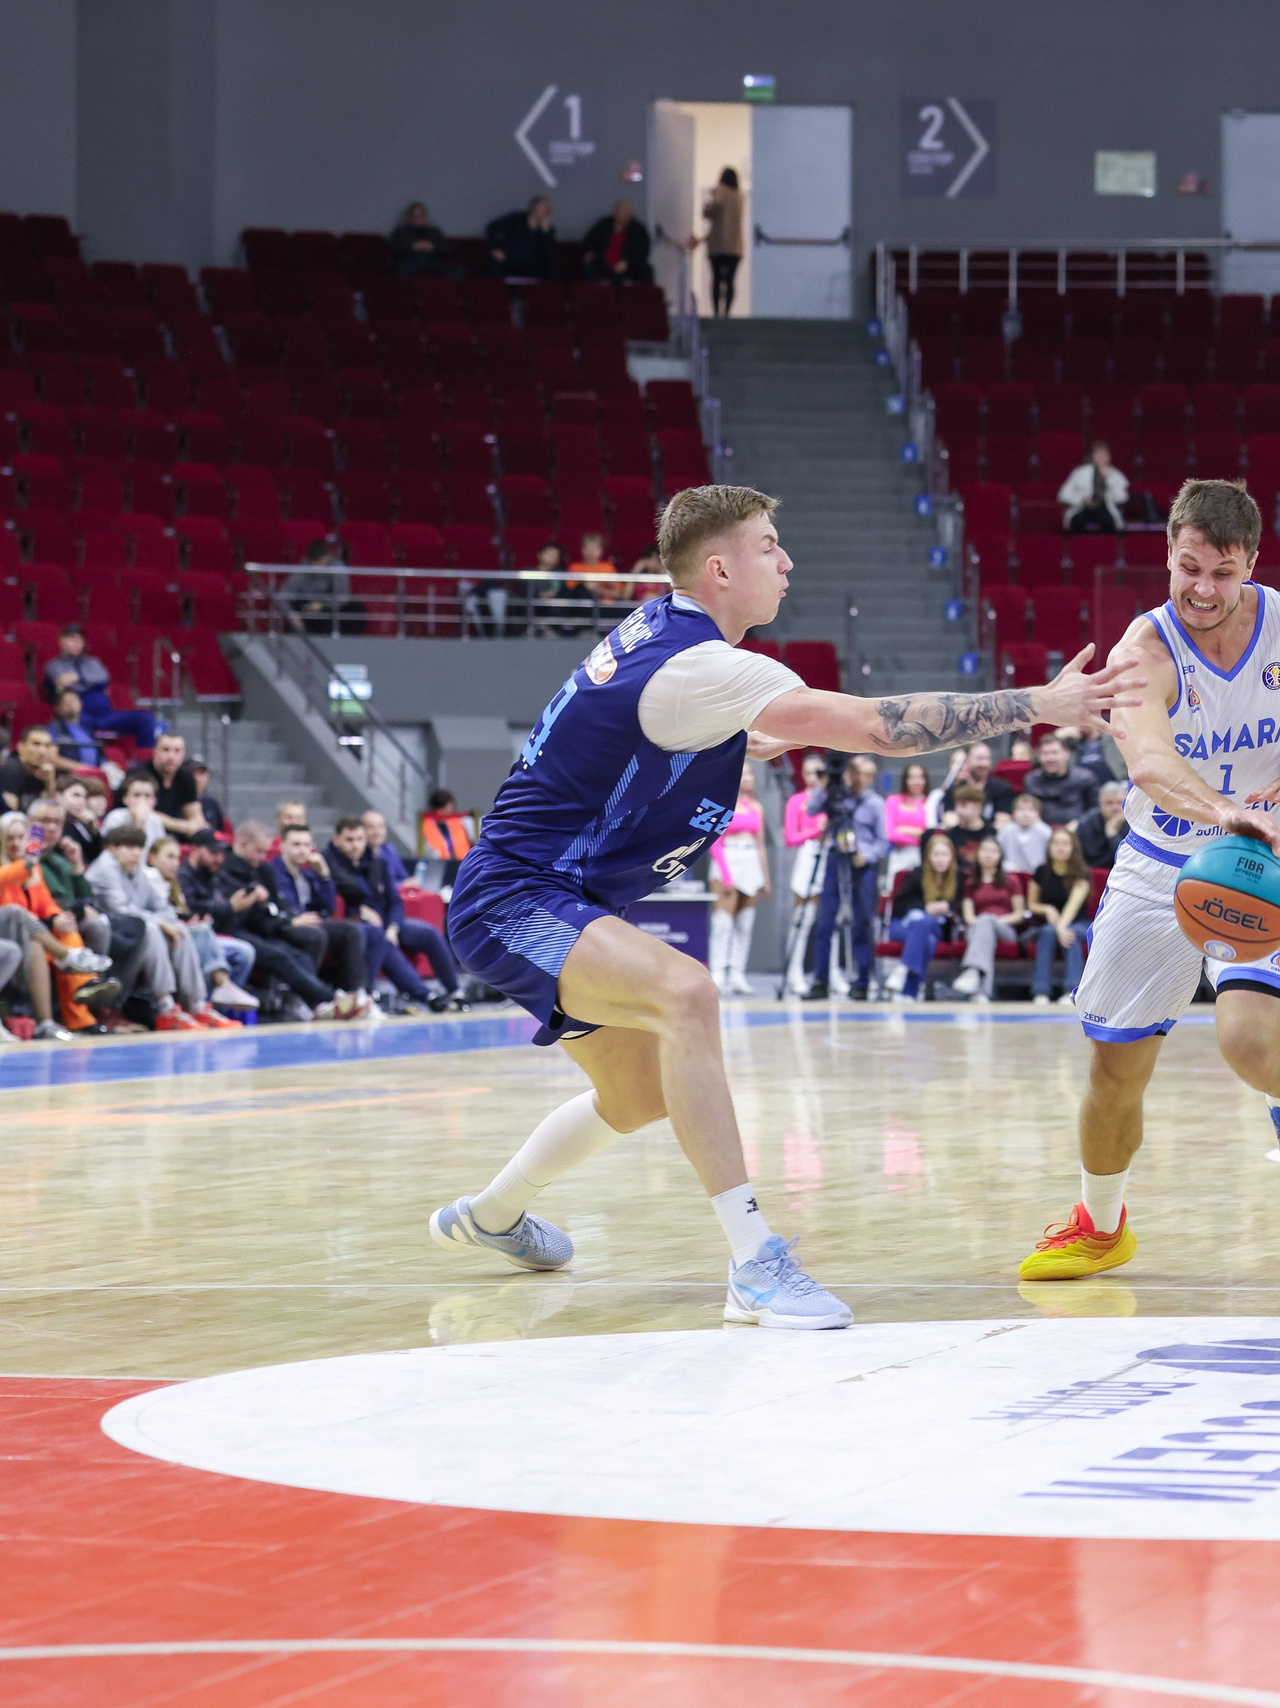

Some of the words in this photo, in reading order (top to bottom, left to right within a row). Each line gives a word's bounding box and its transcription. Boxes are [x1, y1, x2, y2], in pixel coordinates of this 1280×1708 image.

[564, 95, 581, 139] 1
[919, 105, 944, 149] 2
[1217, 764, 1236, 796] 1
[1236, 856, 1265, 875] FIBA
[1193, 897, 1270, 933] JÖGEL
